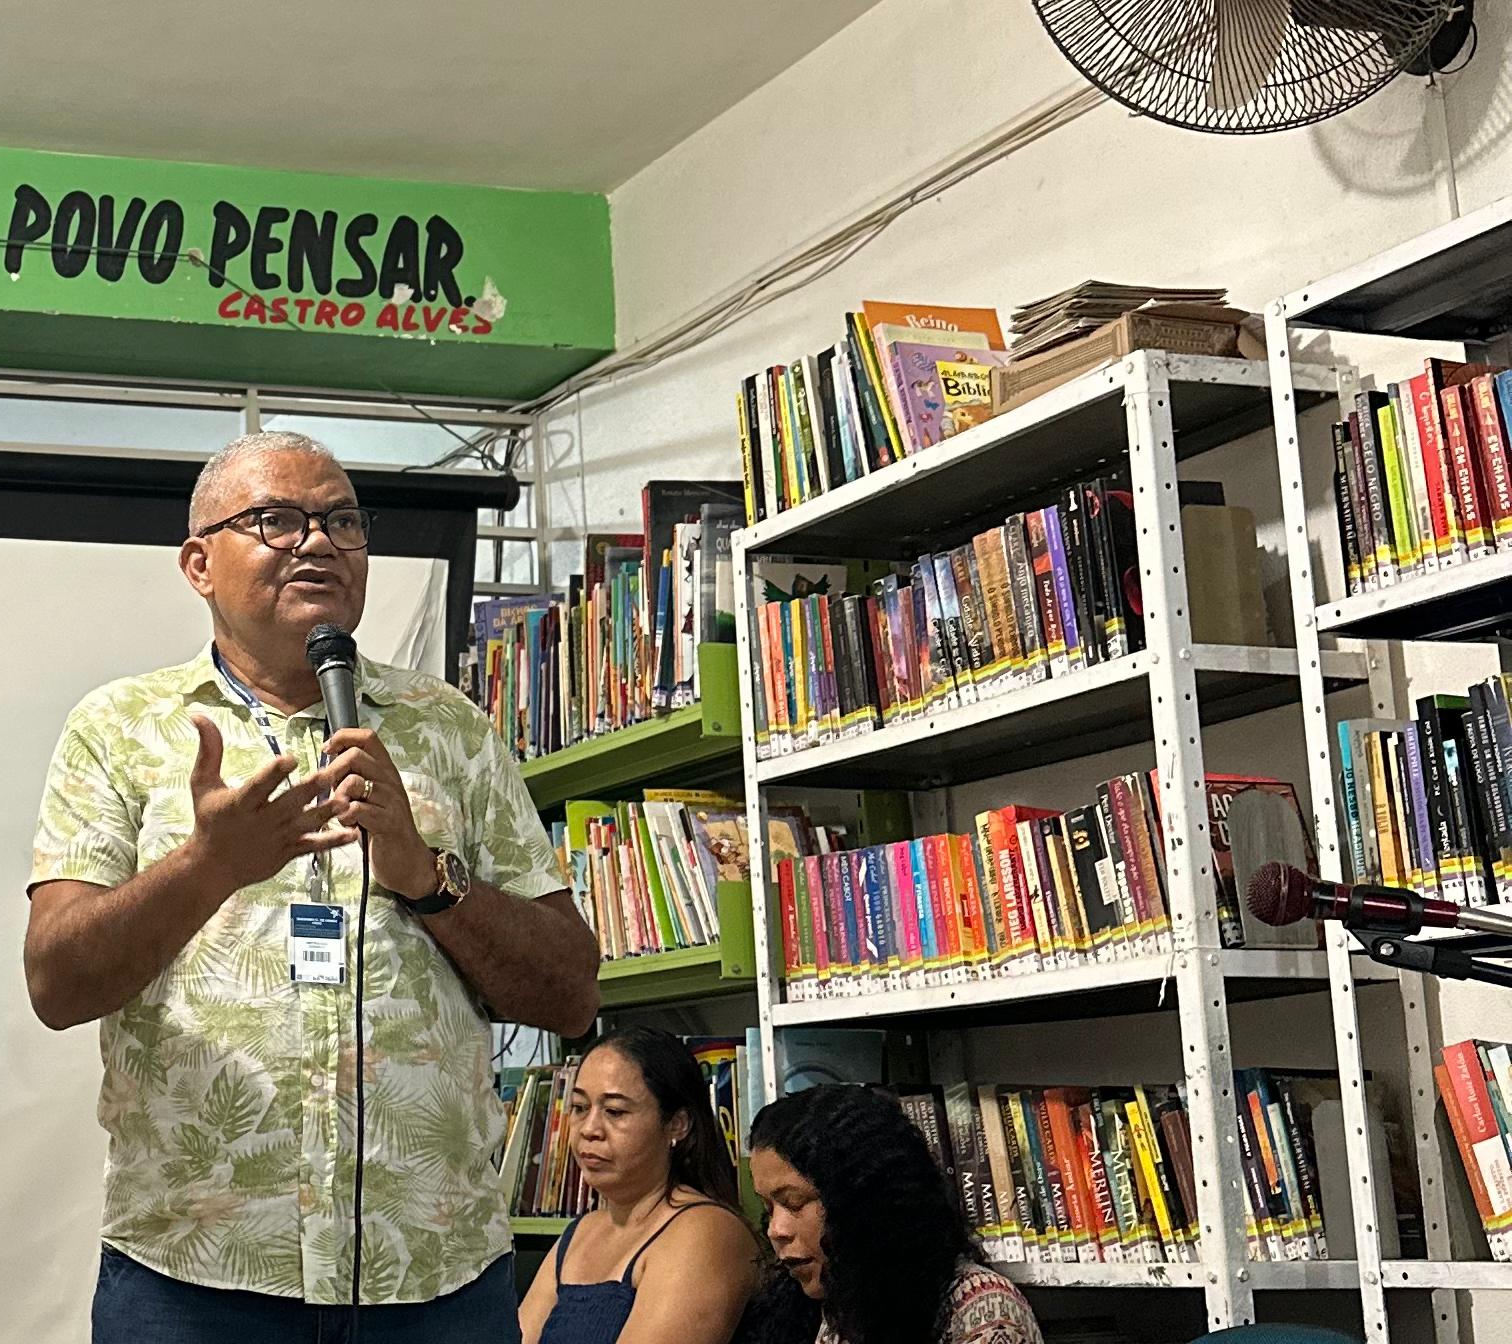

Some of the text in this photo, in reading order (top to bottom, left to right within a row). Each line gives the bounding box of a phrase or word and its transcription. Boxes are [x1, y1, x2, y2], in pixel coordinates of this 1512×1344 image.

[4, 184, 185, 286] POVO
[218, 291, 492, 335] CASTRO ALVES
[1361, 441, 1384, 521] GELO NEGRO
[1458, 469, 1476, 521] CHAMAS
[1492, 458, 1511, 511] CHAMAS
[1100, 794, 1117, 845] Pete Dexter
[840, 855, 853, 902] MEG CABOT
[998, 848, 1023, 945] STIEG LARSSON
[1114, 861, 1135, 924] Paperboy
[1463, 1080, 1477, 1102] Ruiz
[1471, 1102, 1487, 1133] Carlos
[960, 1171, 980, 1220] MARTI
[1015, 1185, 1033, 1232] MARTIN
[1051, 1182, 1069, 1233] MARTIN
[1088, 1150, 1114, 1224] MERLIN
[1110, 1149, 1138, 1234] MERLIN
